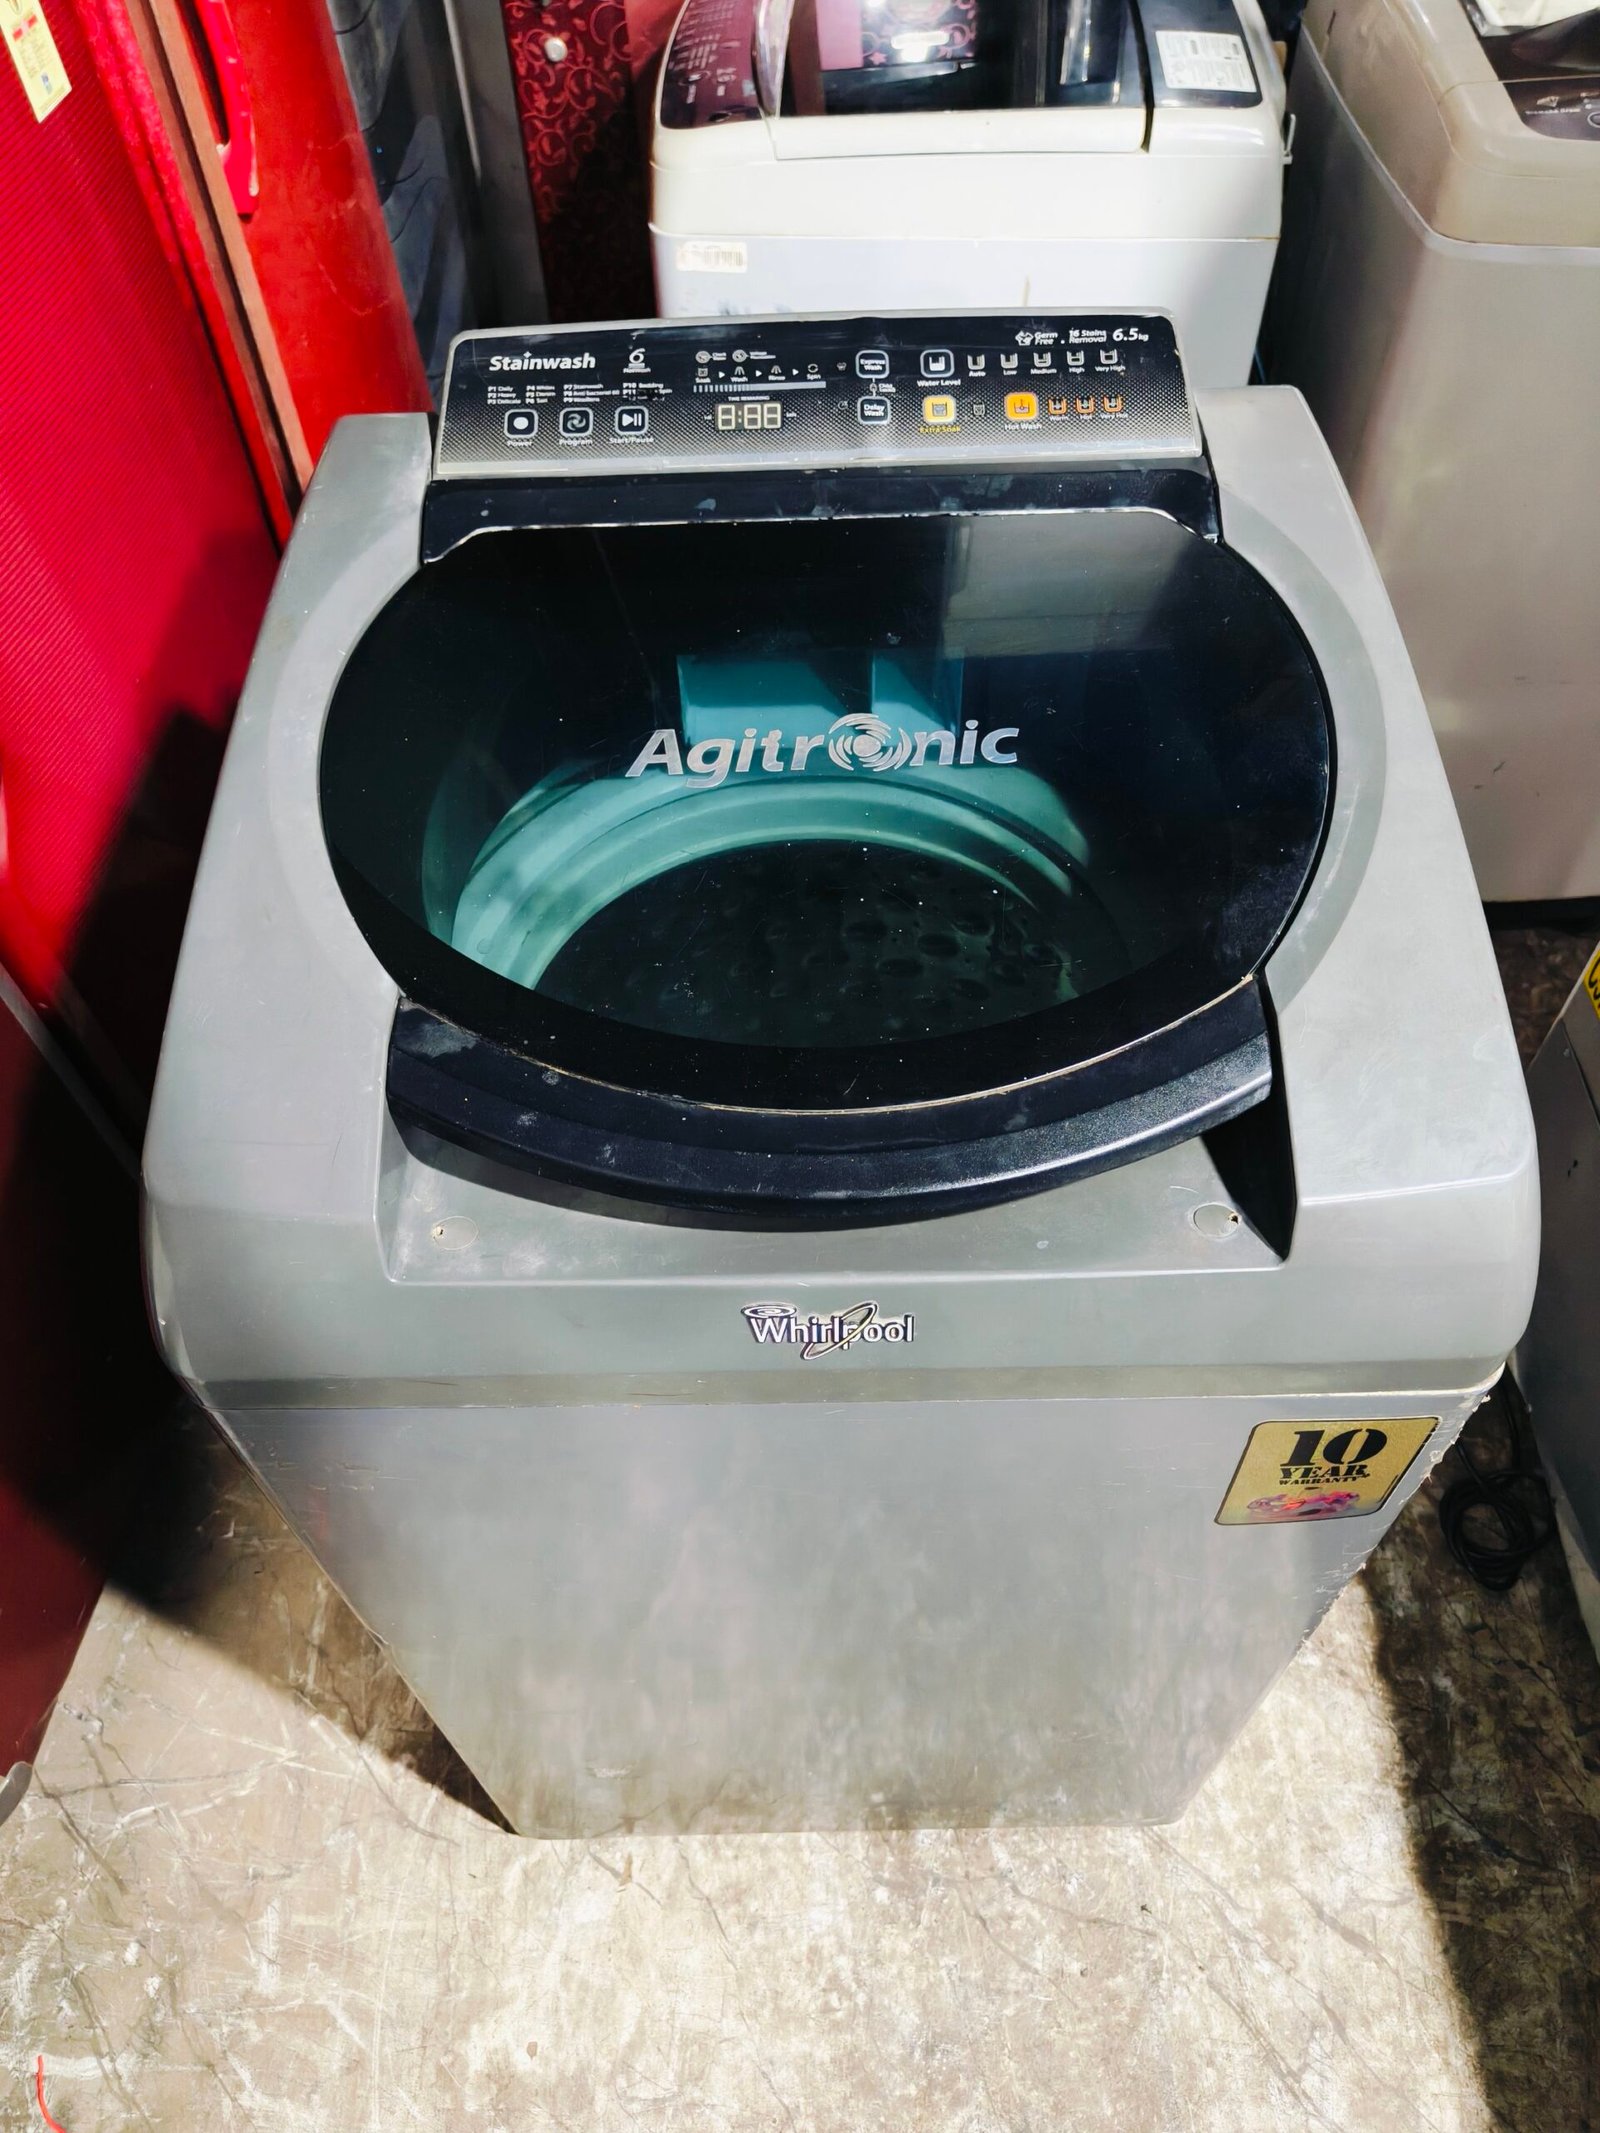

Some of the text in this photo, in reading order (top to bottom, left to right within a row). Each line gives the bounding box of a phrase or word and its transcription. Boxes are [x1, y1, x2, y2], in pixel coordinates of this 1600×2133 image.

[1034, 331, 1058, 339] Germ
[1081, 329, 1107, 337] Stains
[1069, 336, 1107, 344] Removal
[629, 348, 646, 364] 6
[489, 351, 596, 371] Stainwash
[1110, 364, 1126, 372] High
[916, 379, 939, 387] Water
[559, 438, 593, 447] Program
[747, 1307, 914, 1354] Whirlpool
[1279, 1428, 1388, 1467] 10
[1280, 1464, 1370, 1479] YEAR
[1279, 1476, 1358, 1486] WARRANTY
